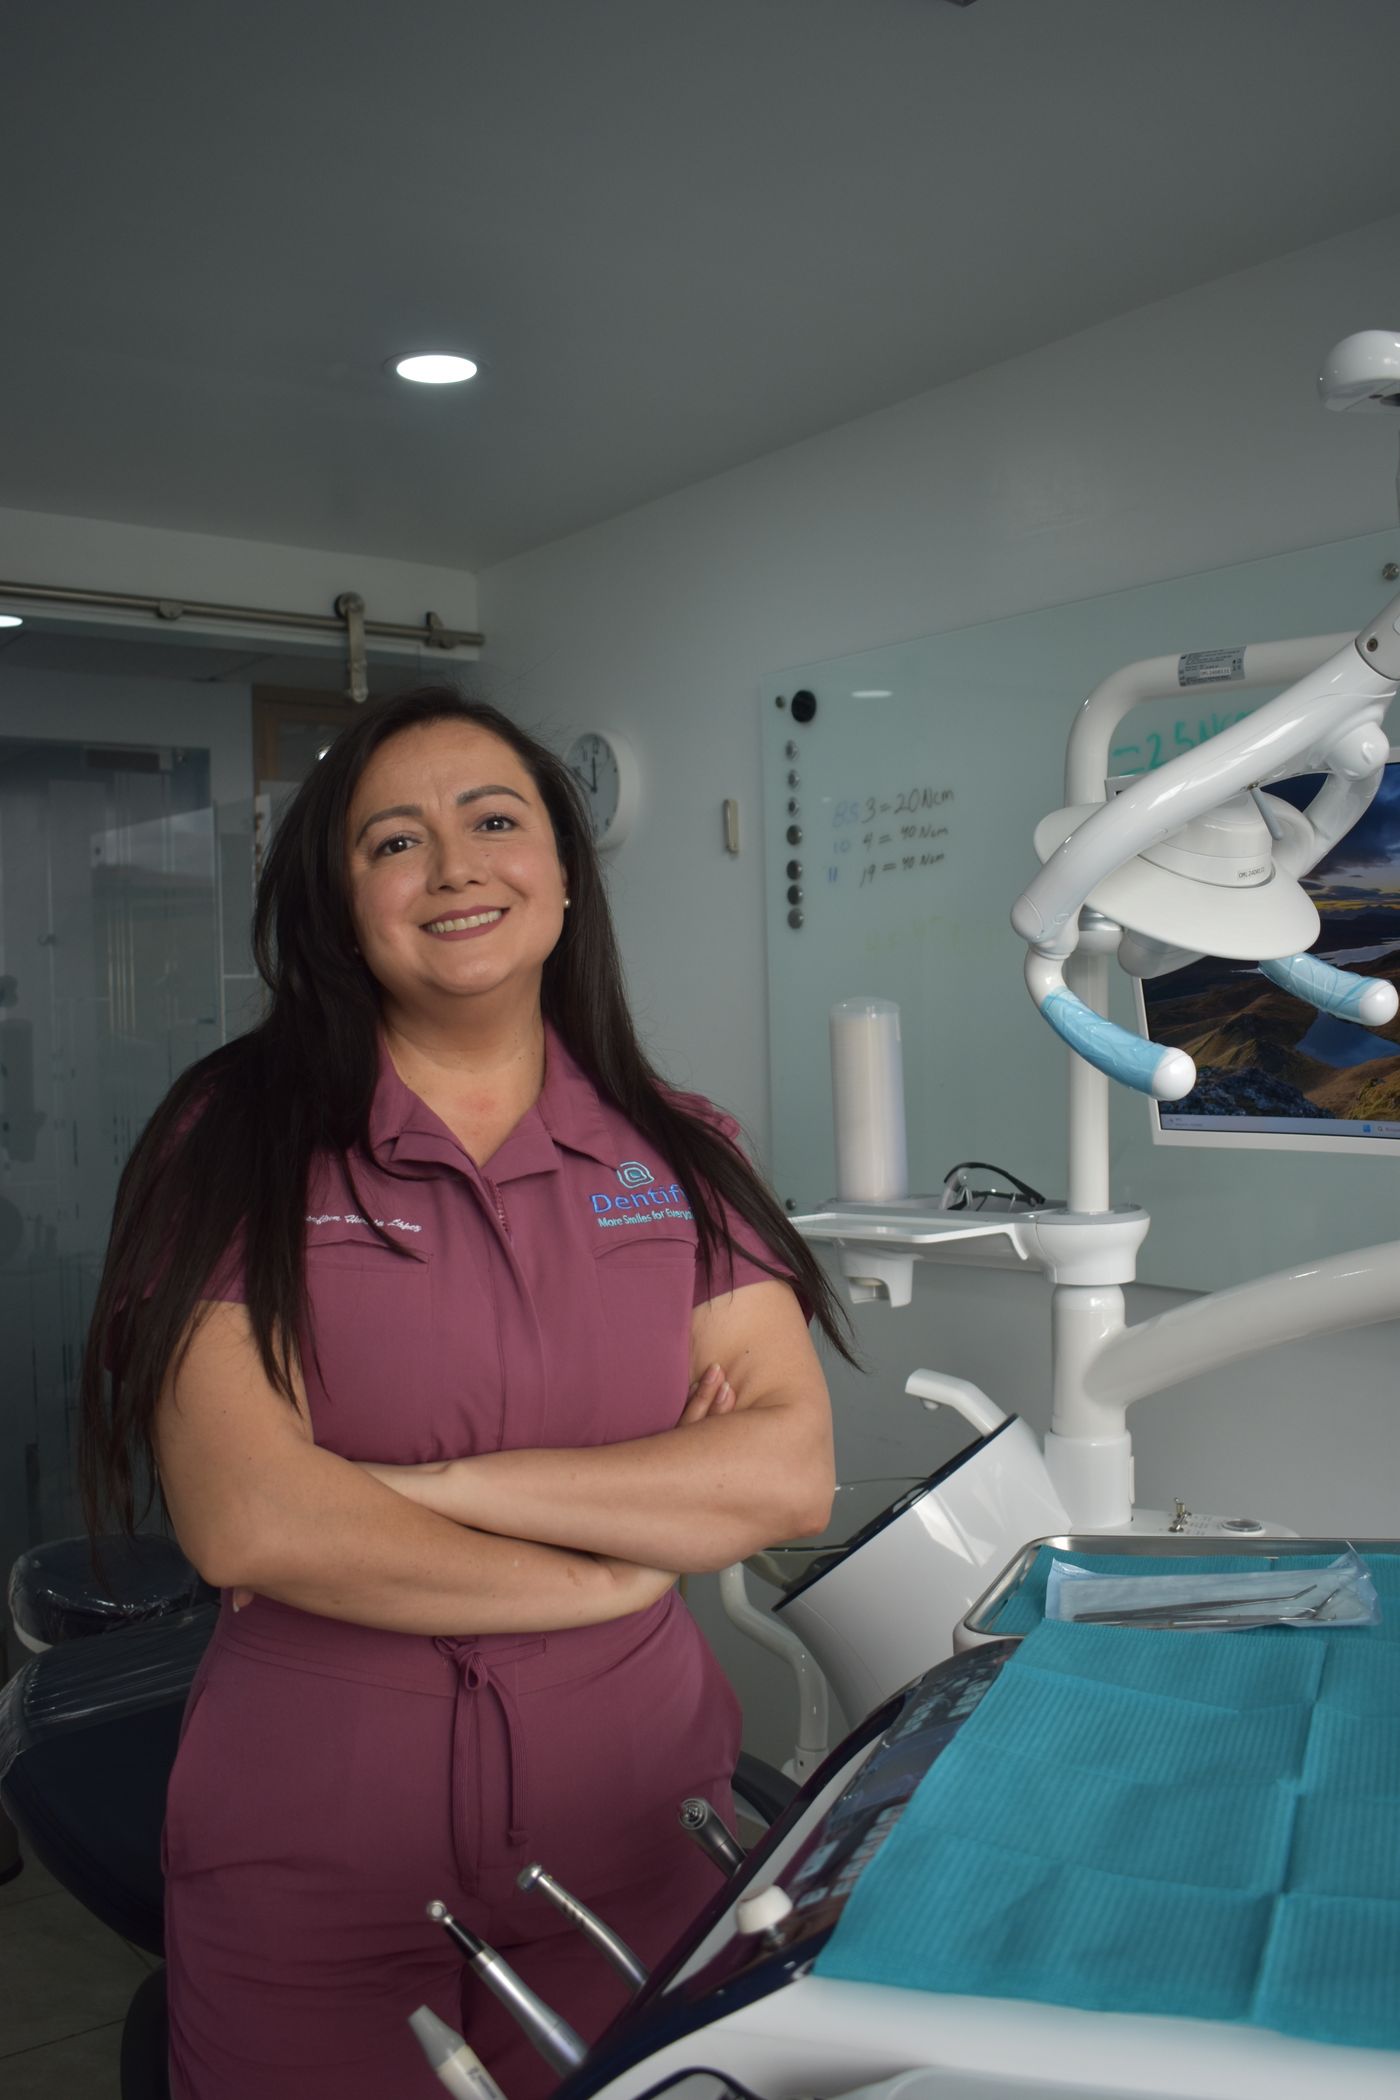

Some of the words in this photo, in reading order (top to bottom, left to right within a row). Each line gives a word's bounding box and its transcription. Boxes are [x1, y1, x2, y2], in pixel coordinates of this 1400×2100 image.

[598, 1217, 623, 1228] More
[622, 1213, 652, 1224] Smiles
[651, 1209, 665, 1220] for
